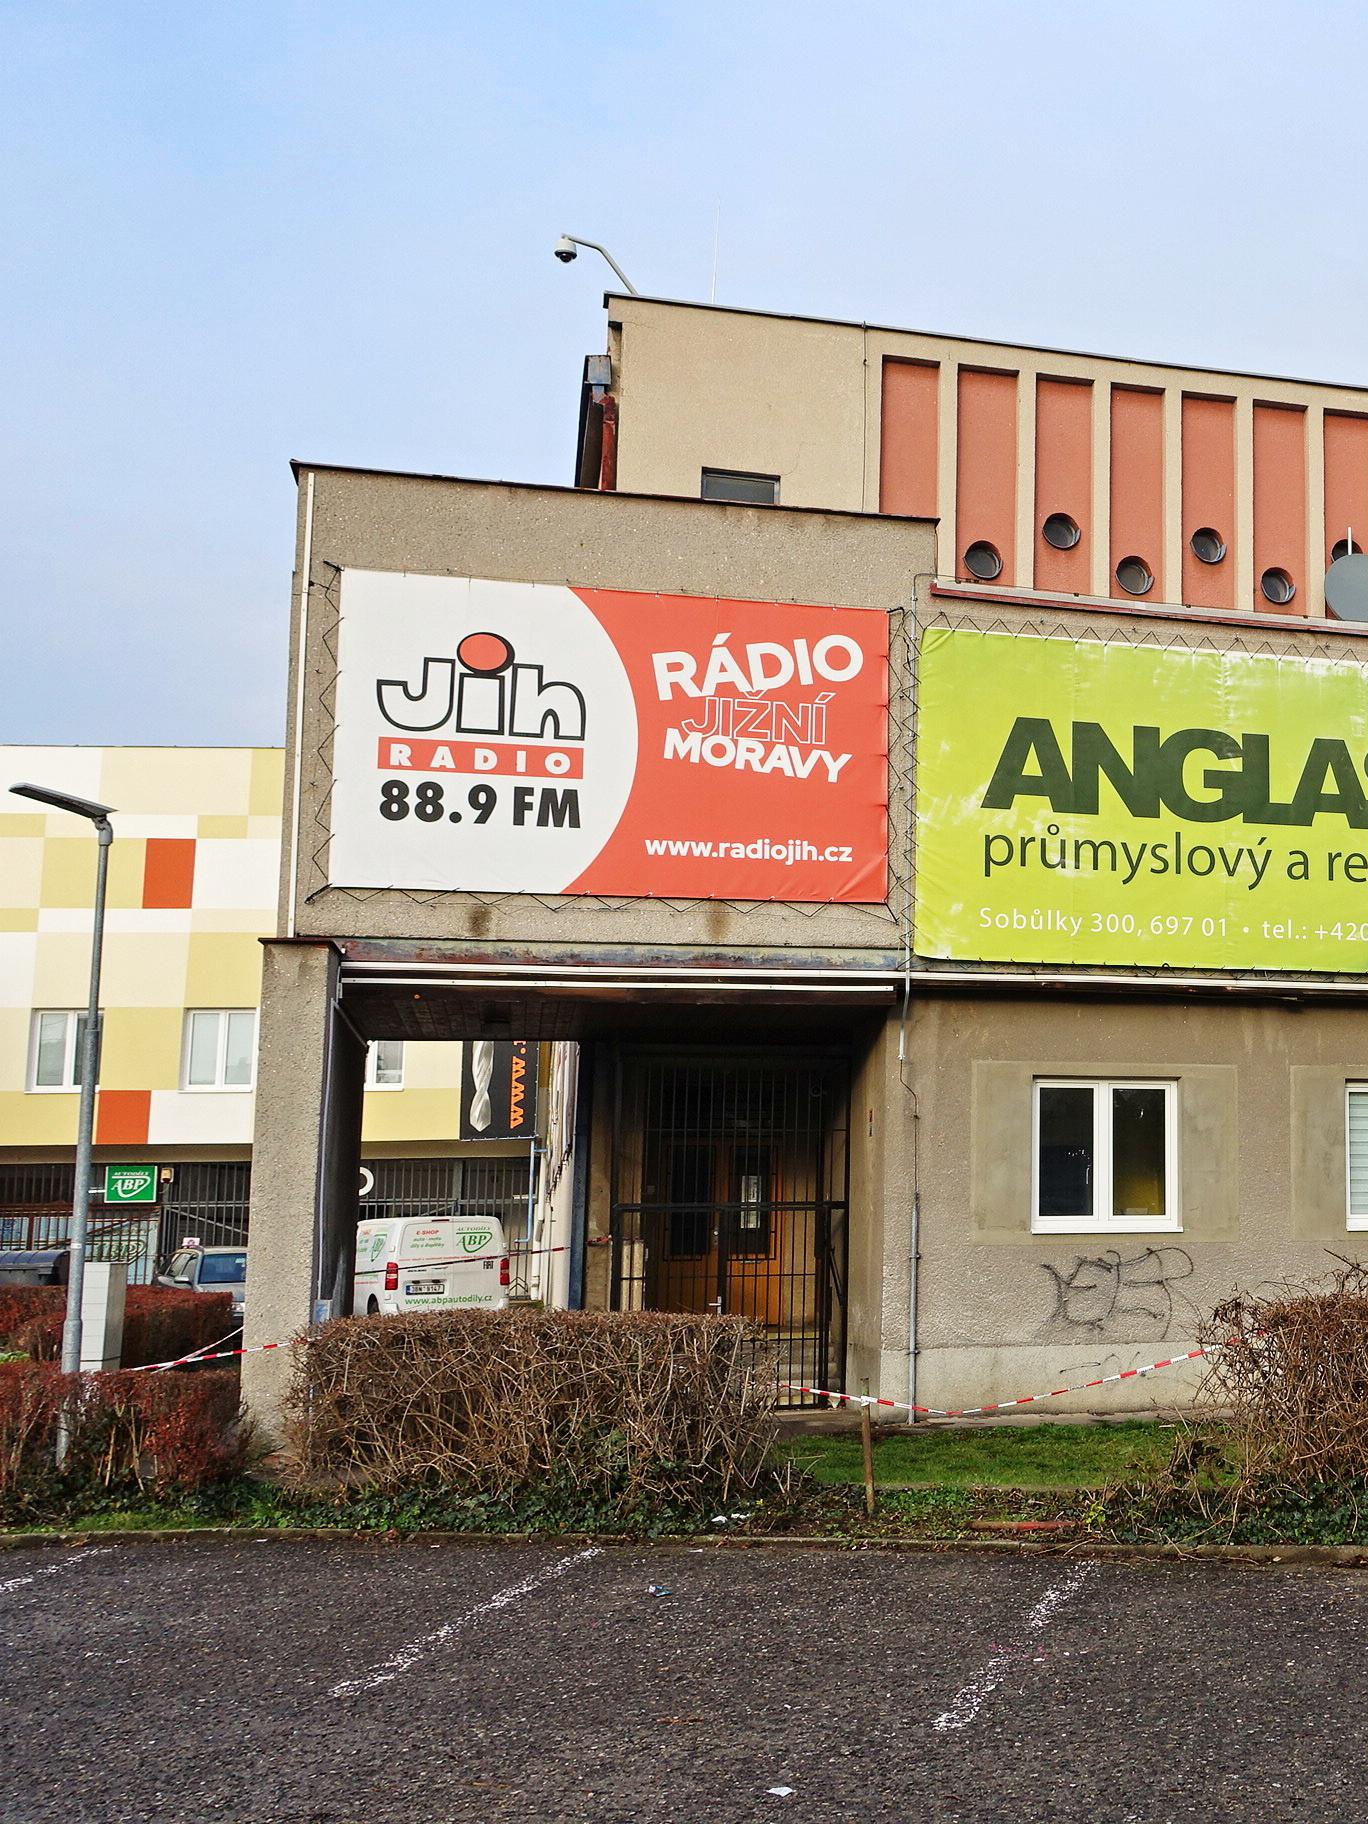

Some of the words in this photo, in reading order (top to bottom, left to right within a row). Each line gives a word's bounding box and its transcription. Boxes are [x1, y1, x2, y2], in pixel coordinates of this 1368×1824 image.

[651, 632, 864, 701] RÁDIO
[681, 690, 837, 745] JIŽNÍ
[389, 743, 571, 774] RADIO
[663, 727, 852, 783] MORAVY
[379, 779, 497, 824] 88.9
[513, 786, 581, 829] FM
[644, 838, 853, 865] www.radiojih.cz
[983, 823, 1273, 890] průmyslový
[1286, 849, 1310, 880] a
[979, 907, 1083, 937] Sobůlky
[1090, 912, 1143, 937] 300,
[1150, 915, 1194, 936] 697
[1201, 917, 1226, 937] 01
[1262, 919, 1307, 940] tel.:
[110, 1179, 145, 1190] ABP
[456, 1234, 487, 1247] ABP
[482, 1260, 494, 1270] FIAT
